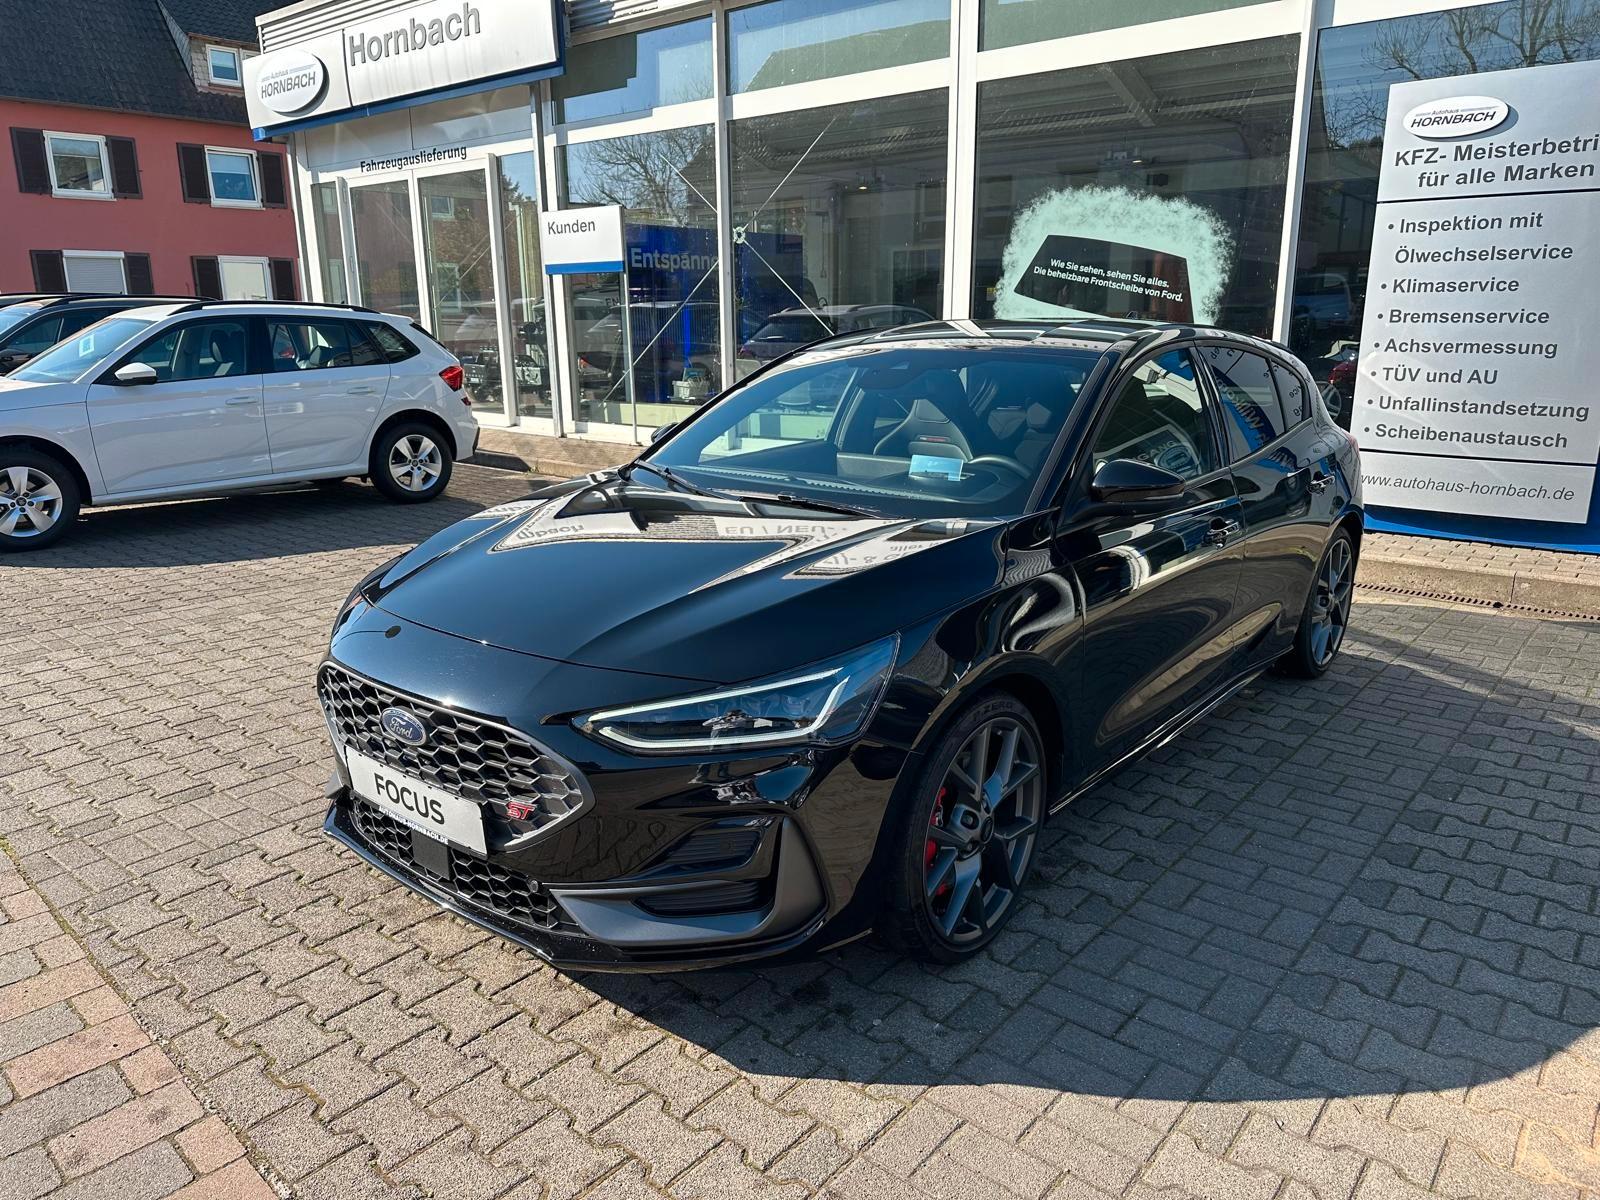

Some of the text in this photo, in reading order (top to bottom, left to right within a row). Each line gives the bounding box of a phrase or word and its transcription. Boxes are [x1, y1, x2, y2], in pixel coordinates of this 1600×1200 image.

[349, 2, 481, 67] Hornbach
[261, 71, 316, 99] HORNBACH
[1410, 111, 1497, 128] HORNBACH
[1431, 108, 1460, 116] Autohaus
[360, 145, 467, 173] Fahrzeugauslieferung
[1394, 134, 1600, 167] KFZ- Meisterbetri
[1418, 162, 1595, 188] für alle Marken
[547, 219, 596, 235] Kunden
[1399, 212, 1543, 235] Inspektion mit
[1395, 243, 1574, 264] Ölwechselservice
[1033, 266, 1184, 302] Die beheizbare Frontscheibe von Ford.
[1050, 258, 1169, 288] Wie Sie sehen, sehen Sie alles.
[1392, 276, 1520, 294] Klimaservice
[1389, 308, 1550, 324] Bremsenservice
[1384, 338, 1558, 359] Achsvermessung
[1382, 364, 1498, 385] TÜV und AU
[1378, 395, 1590, 422] Unfallinstandsetzung
[1375, 423, 1568, 448] Scheibenaustausch
[389, 716, 413, 739] Ford
[374, 773, 445, 825] FOCUS
[506, 801, 537, 821] ST
